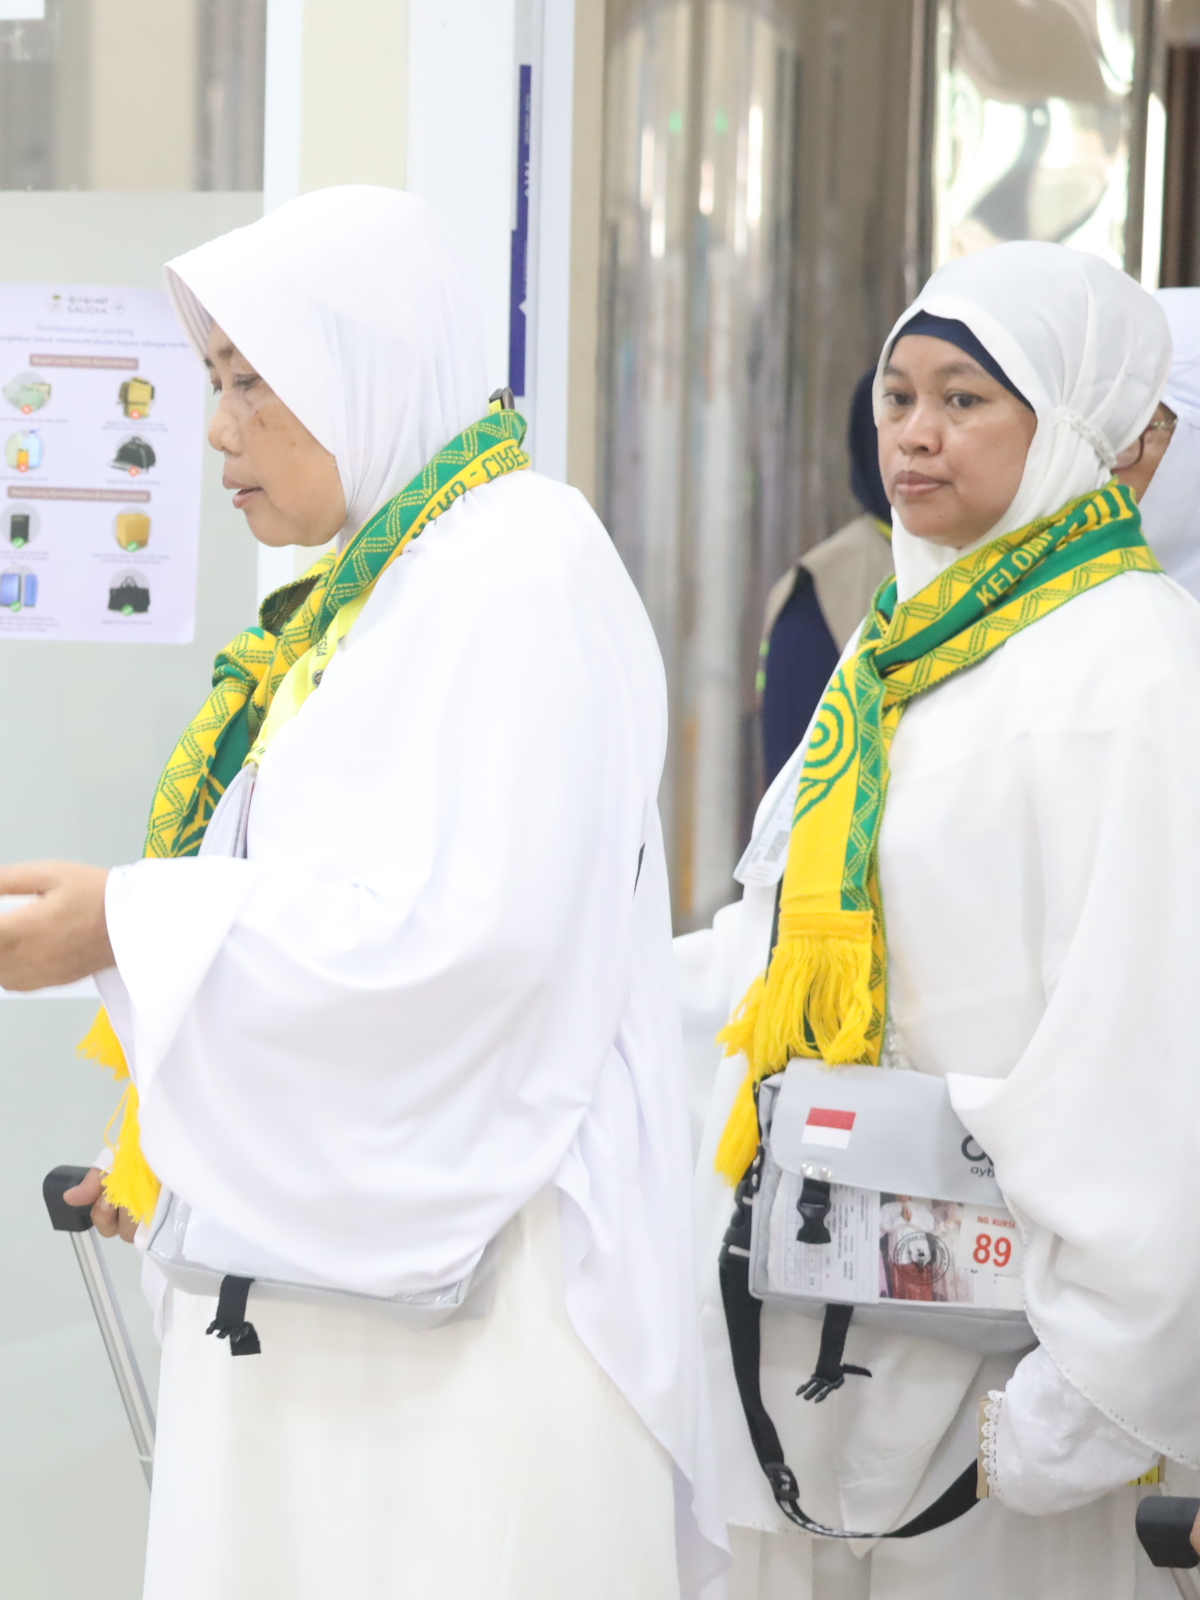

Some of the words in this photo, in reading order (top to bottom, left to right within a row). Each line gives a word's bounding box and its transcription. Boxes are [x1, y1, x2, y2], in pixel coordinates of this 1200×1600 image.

[67, 304, 108, 315] SAUDIA
[992, 1217, 1016, 1229] KURSI
[973, 1233, 1012, 1267] 89
